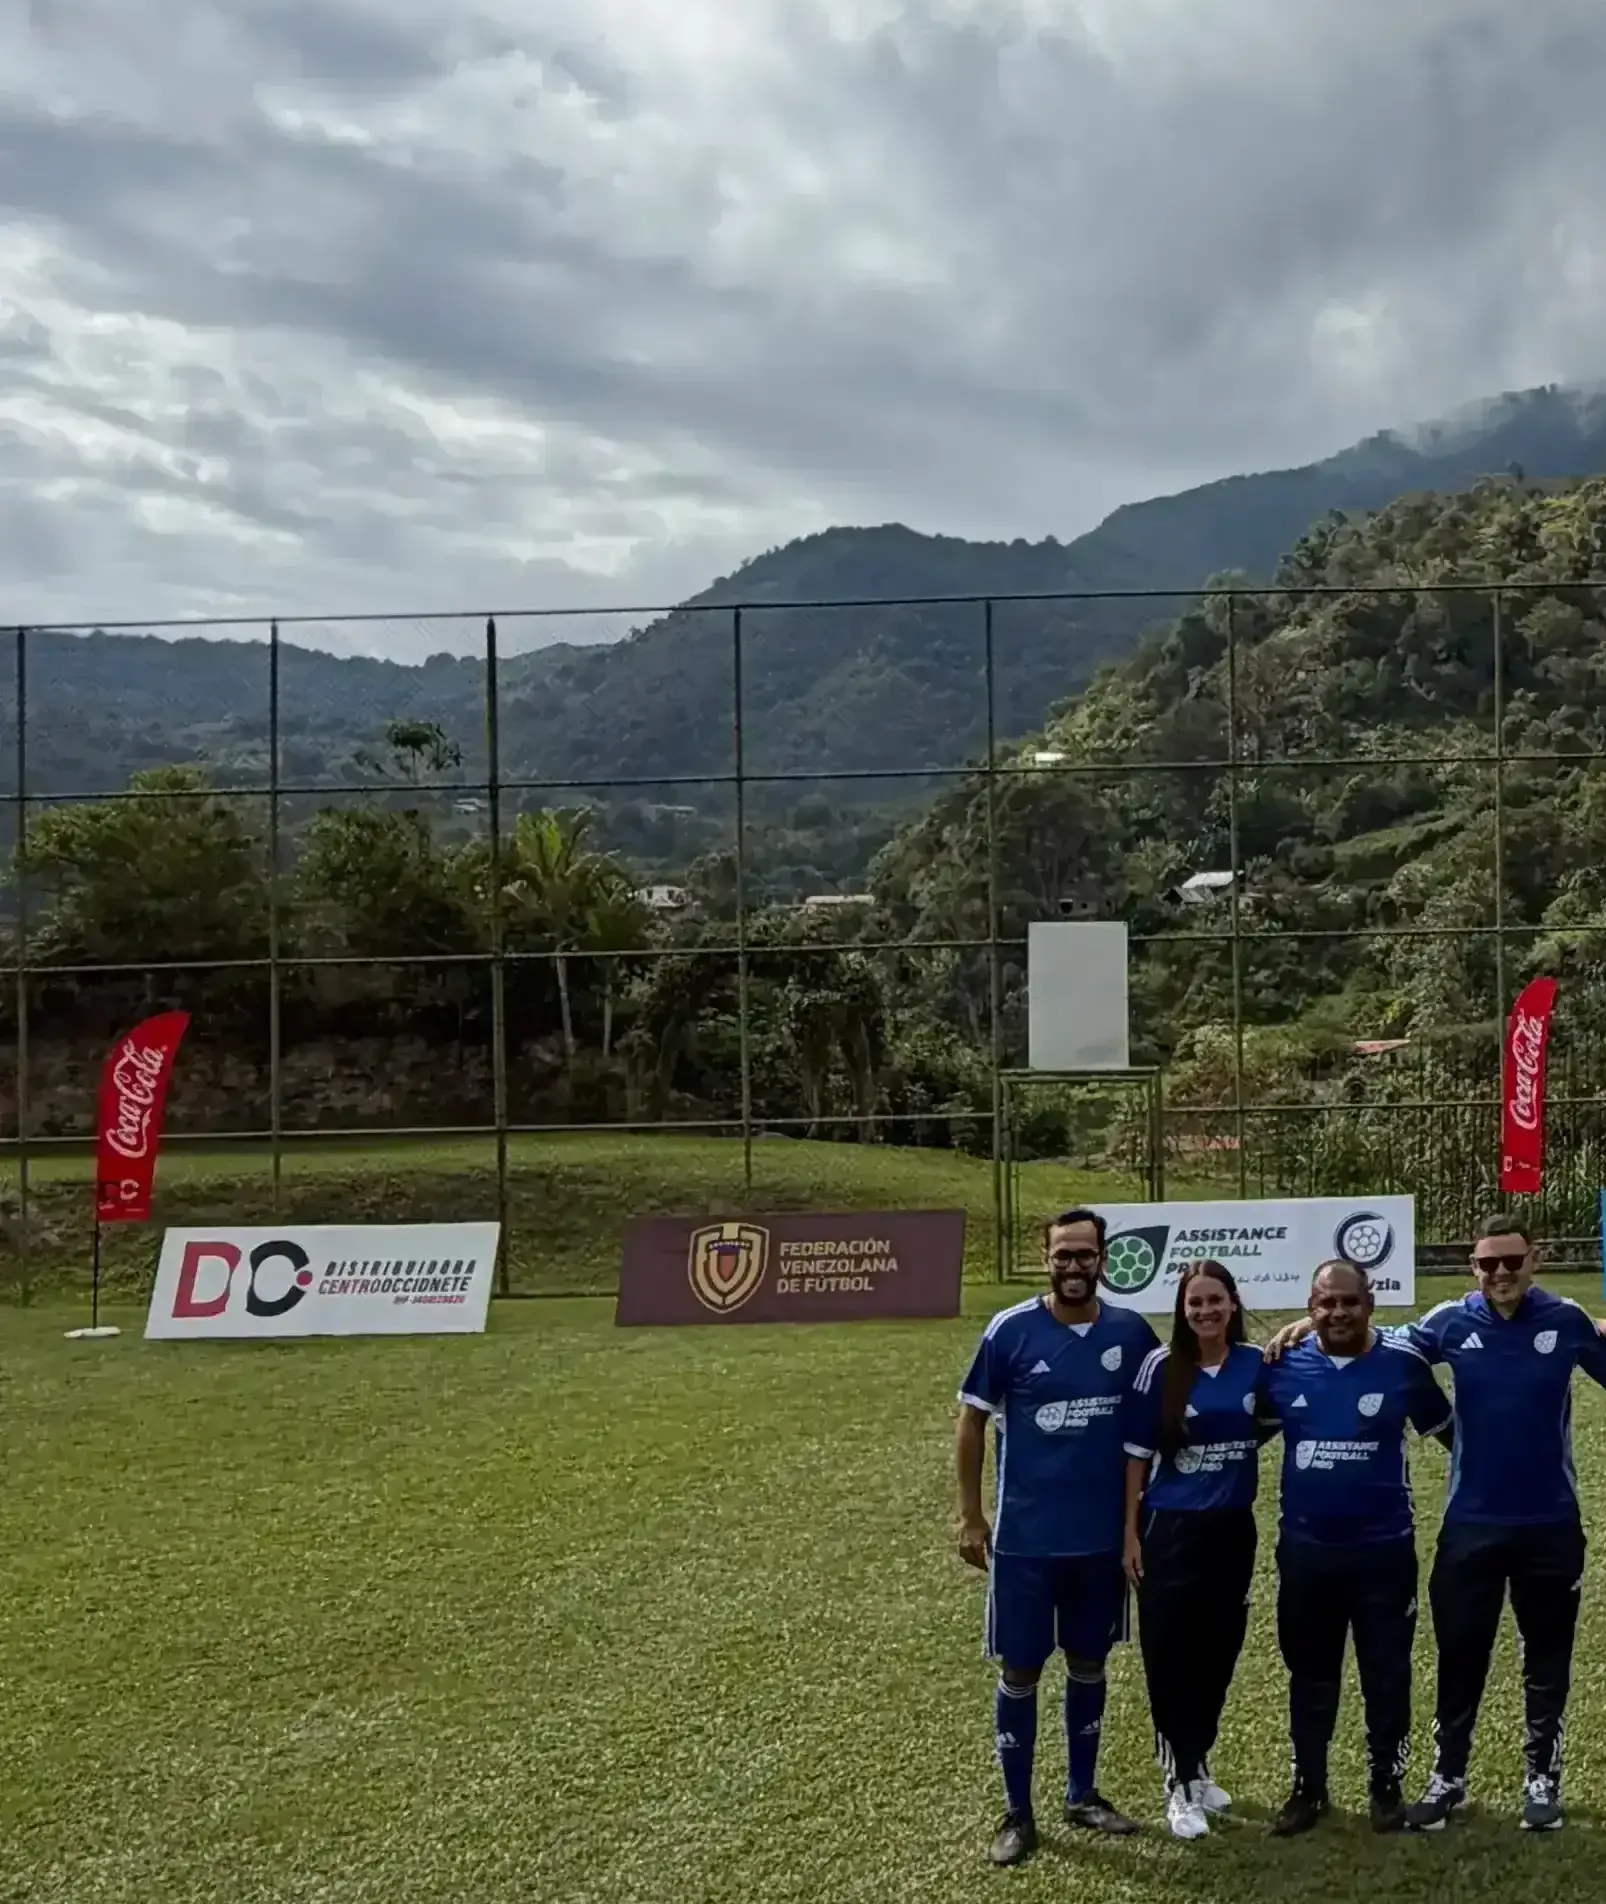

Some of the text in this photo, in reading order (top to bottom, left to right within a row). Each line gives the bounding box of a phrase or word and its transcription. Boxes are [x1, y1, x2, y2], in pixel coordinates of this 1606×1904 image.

[1174, 1227, 1288, 1243] ASSISTANCE
[780, 1236, 890, 1256] FEDERACIÓN
[1169, 1244, 1262, 1259] FOOTBALL
[325, 1259, 477, 1277] DISTRIBUIDORA
[780, 1258, 898, 1275] VENEZOLANA
[318, 1276, 471, 1295] CENTROOCCIDNETE
[777, 1275, 874, 1294] DE FÚTBOL
